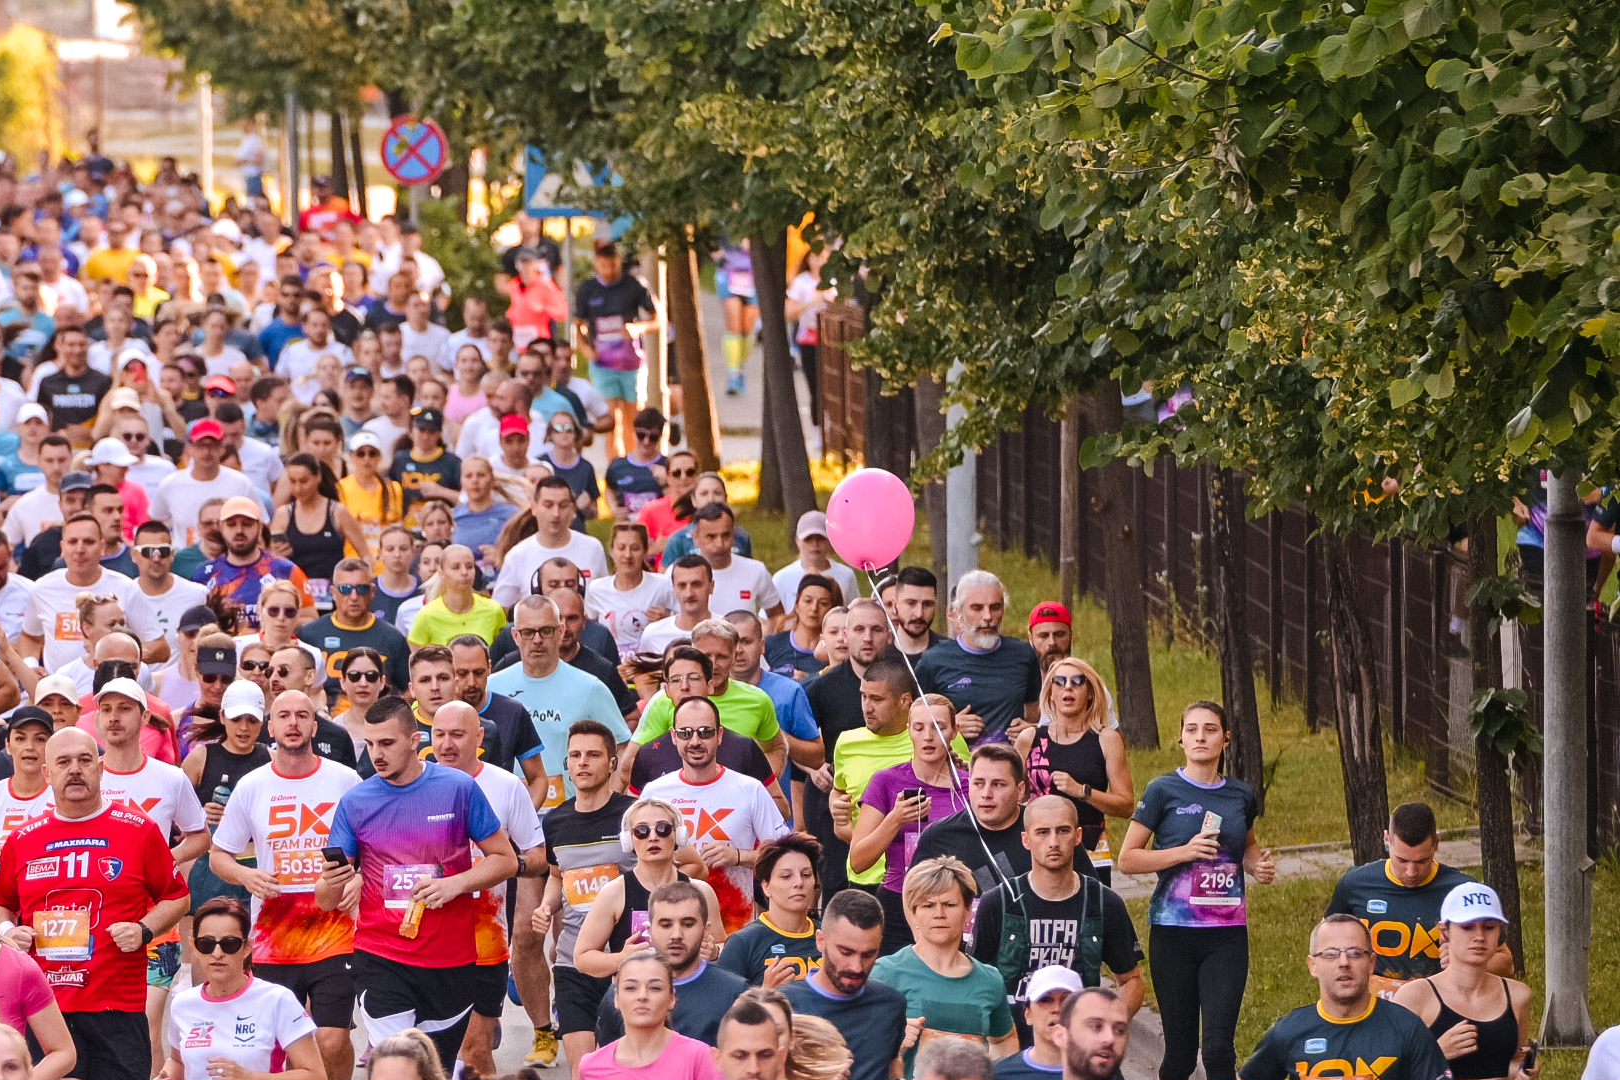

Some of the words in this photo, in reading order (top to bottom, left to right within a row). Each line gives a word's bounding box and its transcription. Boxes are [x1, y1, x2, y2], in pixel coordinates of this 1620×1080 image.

[111, 809, 124, 817] BB
[124, 812, 146, 825] Print
[268, 801, 337, 841] 5K
[54, 839, 107, 850] MAXMARA
[266, 840, 302, 852] TEAM
[29, 862, 56, 874] BEMA
[63, 851, 91, 879] 11
[281, 856, 323, 875] 5035
[1200, 872, 1234, 890] 2196
[1462, 892, 1492, 907] NYC
[40, 918, 78, 938] 1277
[187, 1025, 216, 1041] 5K
[235, 1023, 256, 1035] NRC
